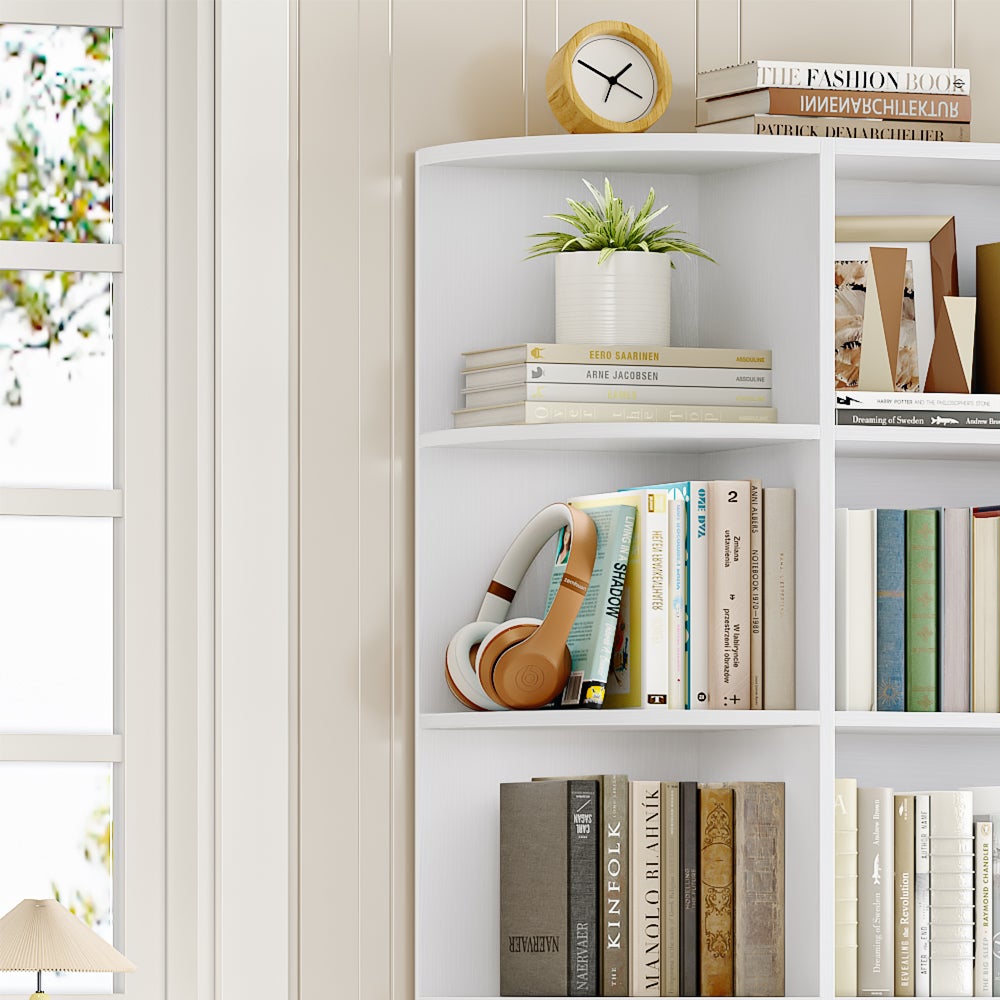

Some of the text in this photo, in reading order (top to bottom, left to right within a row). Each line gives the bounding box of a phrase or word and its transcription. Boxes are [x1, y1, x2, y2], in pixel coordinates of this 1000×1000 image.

[757, 66, 965, 93] THE FASHION BOOK
[756, 123, 944, 142] PATRICK DEMARCHELIER
[589, 350, 660, 362] EERO SAARINEN
[586, 369, 659, 382] ARNE JACOBSEN
[852, 415, 887, 425] Dreaming
[887, 415, 896, 424] of
[896, 416, 924, 425] Sweden
[966, 417, 988, 425] Andrew
[727, 490, 738, 504] 2
[751, 485, 759, 507] ANNI
[622, 515, 635, 543] LIVING
[733, 535, 741, 562] Zmiana
[752, 549, 760, 593] NOTEBOOK
[605, 562, 627, 619] SHADOW
[723, 608, 731, 684] przestrzeni obrazów
[731, 634, 741, 668] labiryncie
[573, 813, 592, 824] SAGAN
[576, 823, 590, 834] CARL
[607, 821, 621, 950] KINFOLK
[641, 788, 659, 990] MANOLO BLAHNÍK
[900, 872, 909, 925] Revolution
[872, 892, 881, 922] Sweden
[872, 923, 881, 934] of
[508, 935, 560, 953] NAERVAER
[576, 921, 588, 991] NAERVAER
[872, 935, 881, 973] Dreaming
[901, 941, 909, 987] REVEALING
